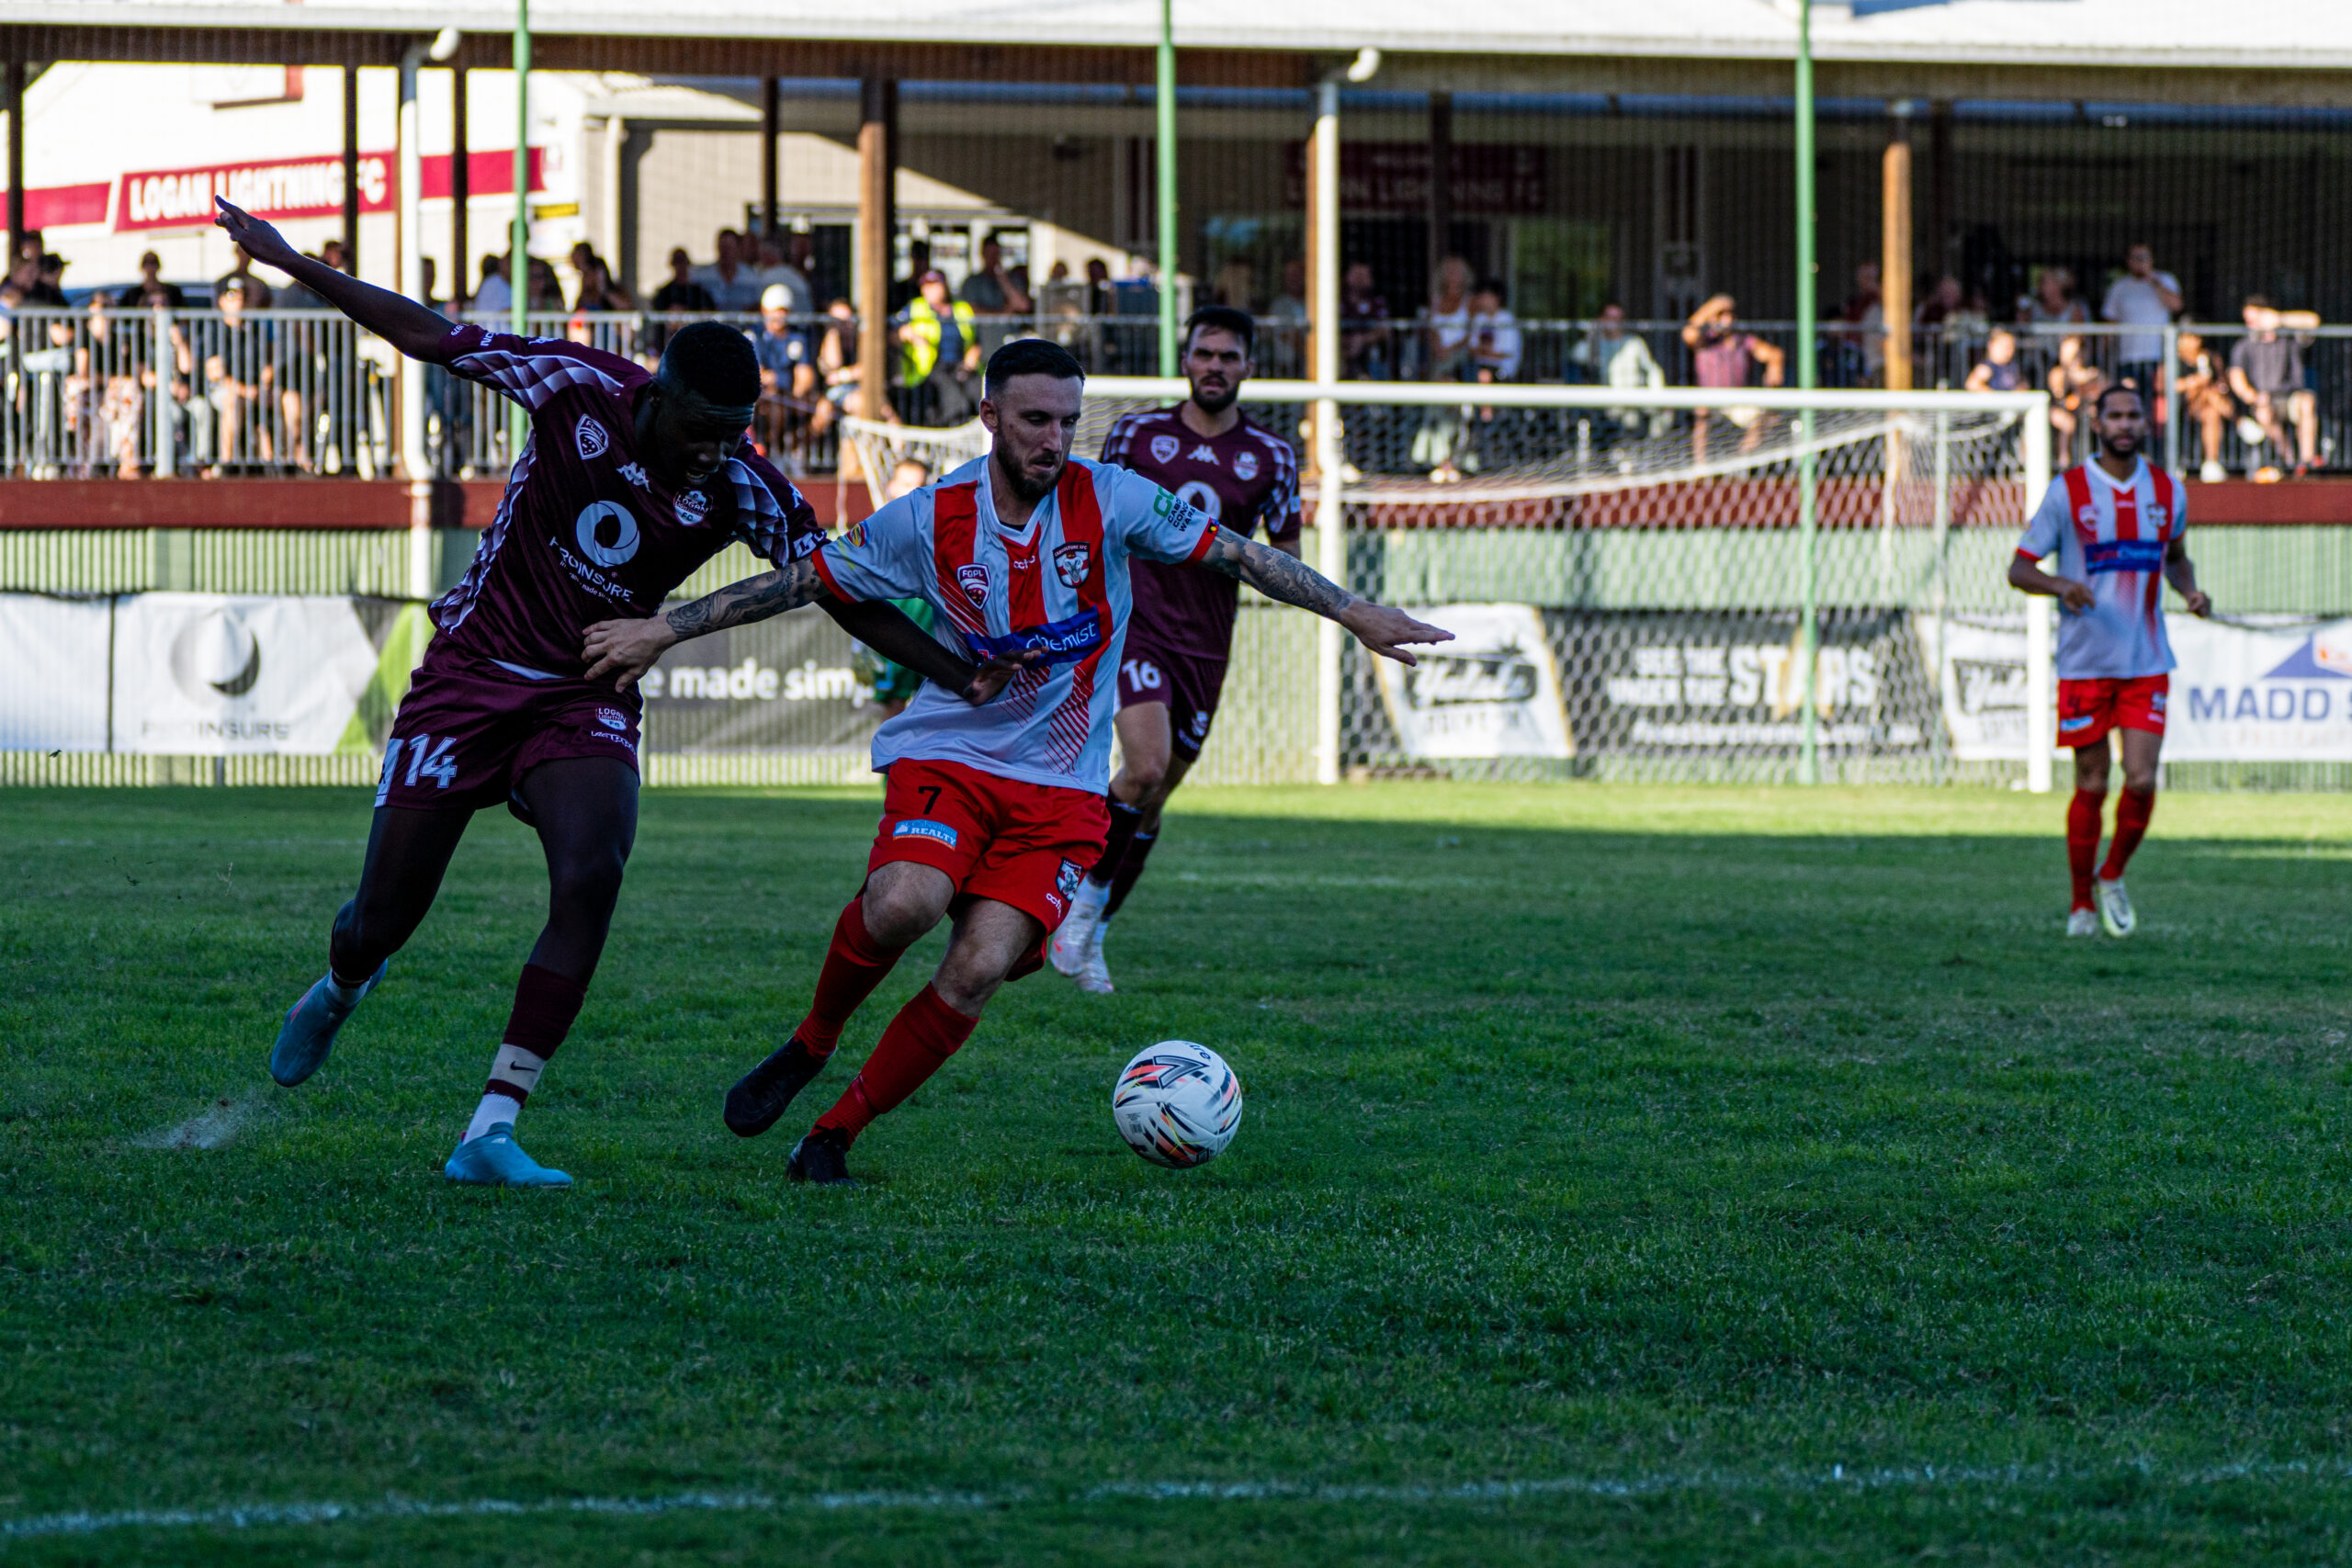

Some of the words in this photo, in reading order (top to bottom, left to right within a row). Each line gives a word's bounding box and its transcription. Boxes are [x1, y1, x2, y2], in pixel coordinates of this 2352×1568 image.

[130, 171, 211, 222] LOGAN
[214, 160, 346, 213] LIGHTNING
[670, 656, 778, 700] made
[1122, 659, 1162, 693] 16
[1730, 645, 1877, 706] STARS
[2189, 687, 2330, 721] MADD
[404, 734, 458, 789] 14
[918, 785, 942, 815] 7
[911, 827, 956, 845] REALTY
